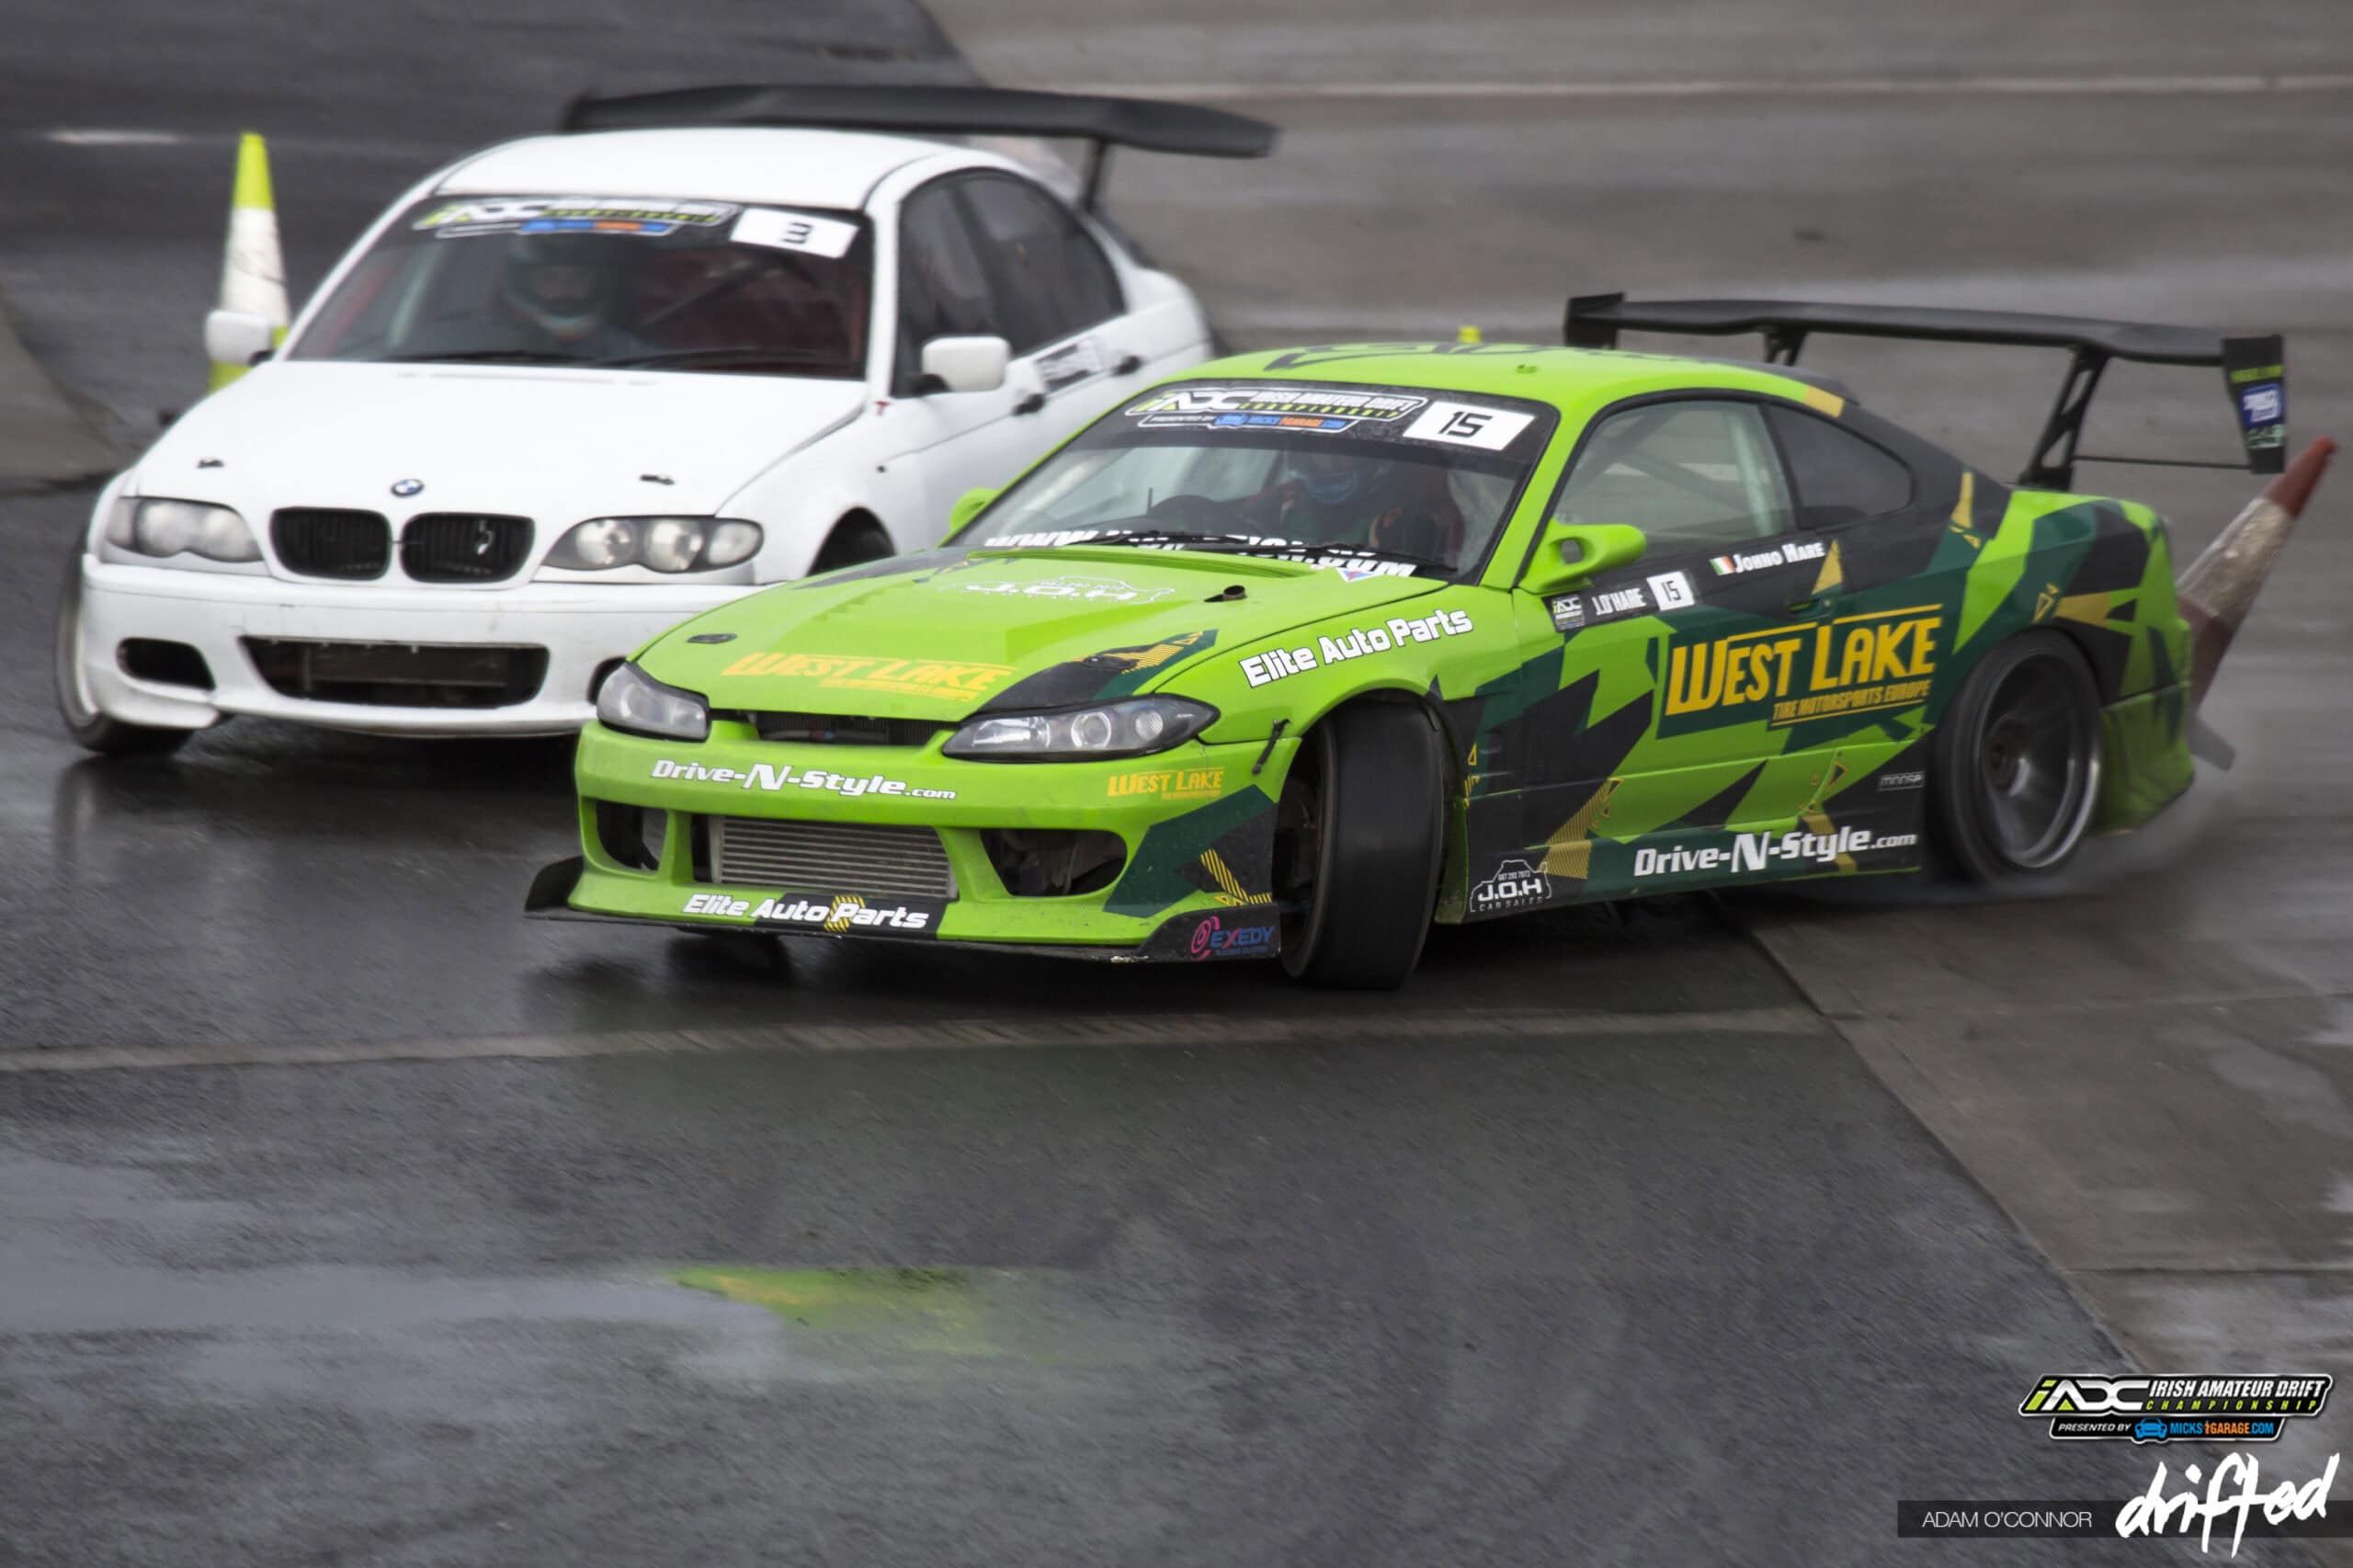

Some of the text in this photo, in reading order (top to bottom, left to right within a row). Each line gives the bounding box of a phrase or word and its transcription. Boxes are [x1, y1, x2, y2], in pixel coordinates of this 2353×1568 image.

[781, 222, 811, 244] 3
[1439, 411, 1493, 438] 15
[1662, 580, 1682, 603] 15
[1239, 609, 1473, 687] Elite Auto Parts
[1665, 618, 1942, 717] WEST LAKE
[651, 758, 956, 800] Drive-N-Style.com
[1633, 825, 1918, 876] Drive-N-Style.com
[1478, 878, 1542, 901] J.O.H
[682, 894, 930, 929] Elite Auto Parts
[1211, 926, 1275, 949] EXEDY
